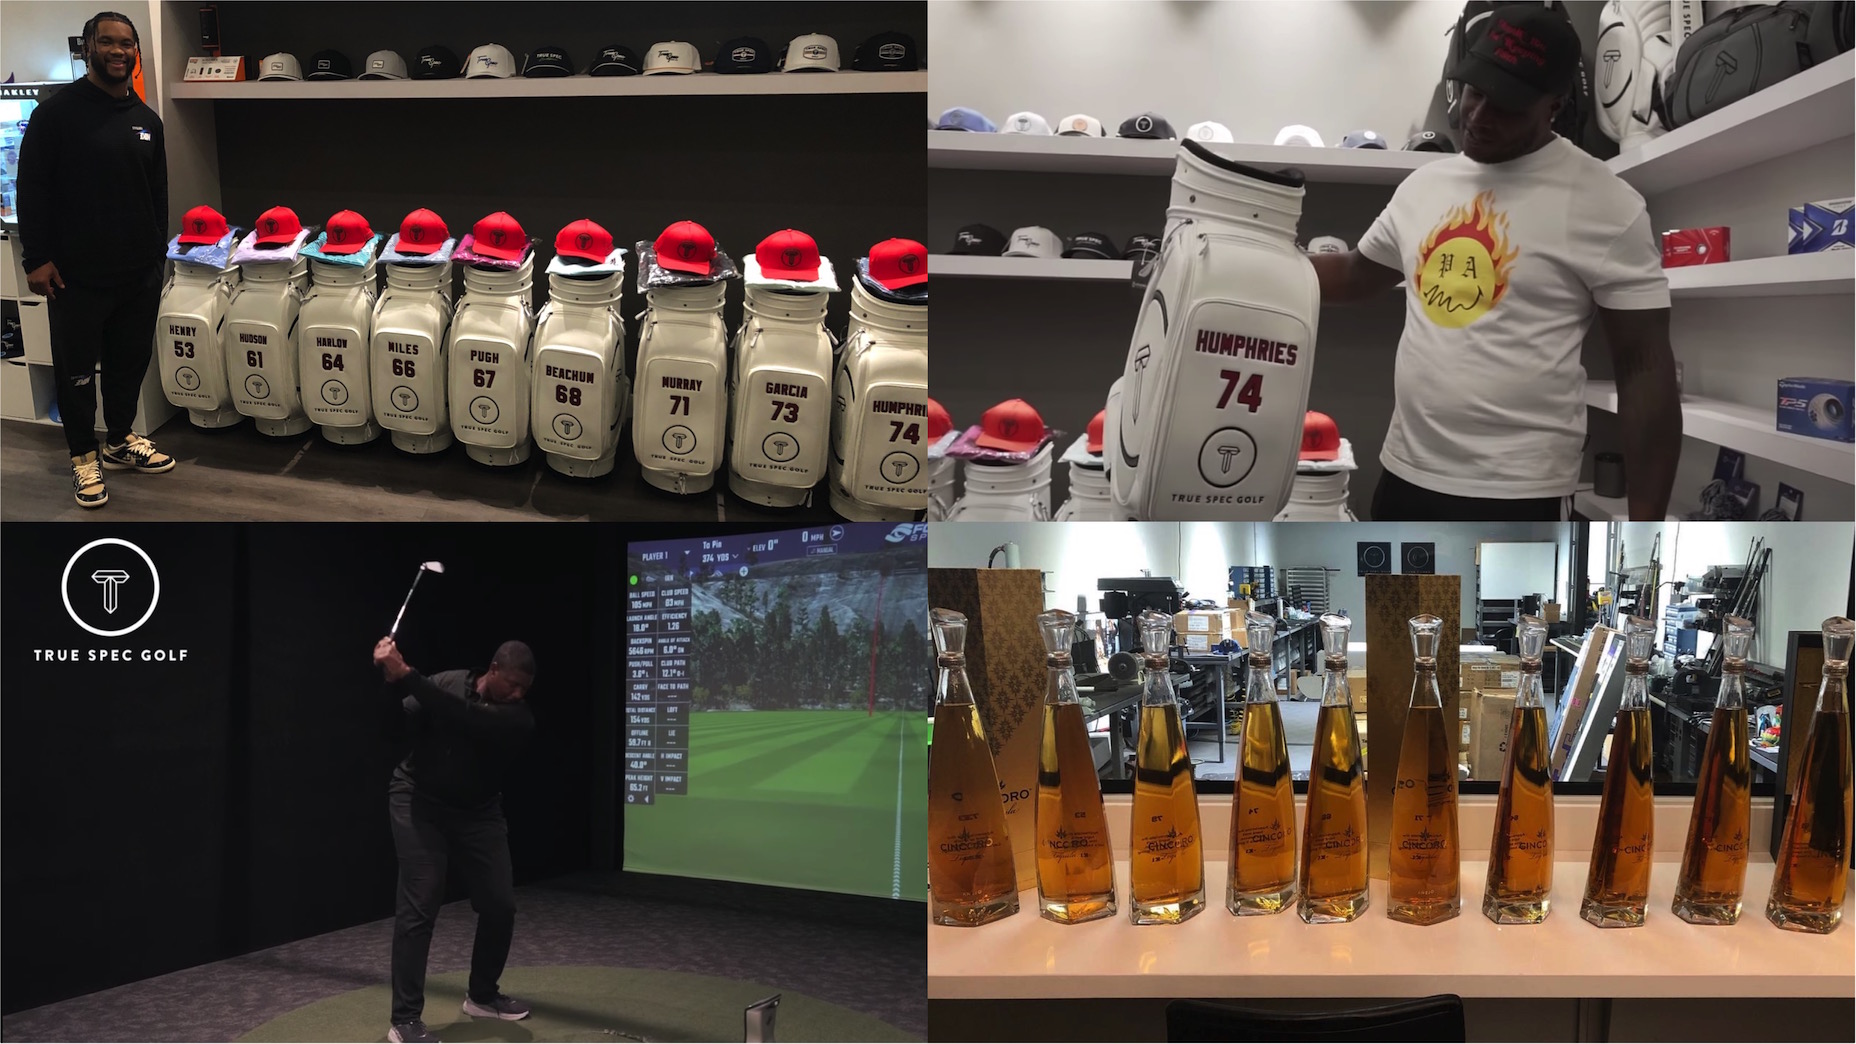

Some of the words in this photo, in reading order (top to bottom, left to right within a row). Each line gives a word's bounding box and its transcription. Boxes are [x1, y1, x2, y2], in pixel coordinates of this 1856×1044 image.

[1461, 256, 1477, 279] A
[169, 324, 197, 337] HENRY
[240, 333, 267, 345] HUDSON
[316, 337, 348, 348] HARLOW
[174, 340, 195, 359] 53
[388, 342, 419, 355] MILES
[1195, 329, 1298, 366] HUMPHRIES
[246, 350, 263, 369] 61
[322, 353, 344, 372] 64
[470, 350, 500, 364] PUGH
[392, 358, 416, 378] 66
[546, 364, 594, 384] BEACHUM
[473, 368, 496, 389] 67
[662, 376, 702, 392] MURRAY
[556, 384, 582, 407] 68
[766, 382, 808, 399] GARCIA
[1216, 369, 1264, 414] 74
[670, 394, 690, 416] 71
[770, 400, 800, 423] 73
[872, 400, 928, 418] HUMPHRI
[888, 420, 920, 445] 74
[1172, 494, 1202, 504] TRUE
[1206, 495, 1233, 504] SPEC
[1236, 496, 1264, 504] GOLF
[702, 541, 710, 549] To
[712, 540, 722, 548] Pin
[810, 534, 824, 542] MPH
[752, 544, 766, 552] ELEV
[642, 552, 664, 561] PLAYER
[702, 554, 714, 563] 374
[641, 590, 656, 598] SPEED
[662, 612, 688, 620] EFFICIENCY
[628, 660, 654, 668] PUSH/PULL
[631, 692, 641, 700] 142
[630, 716, 641, 724] 154
[666, 752, 682, 760] IMPACT
[637, 774, 653, 782] HEIGHT
